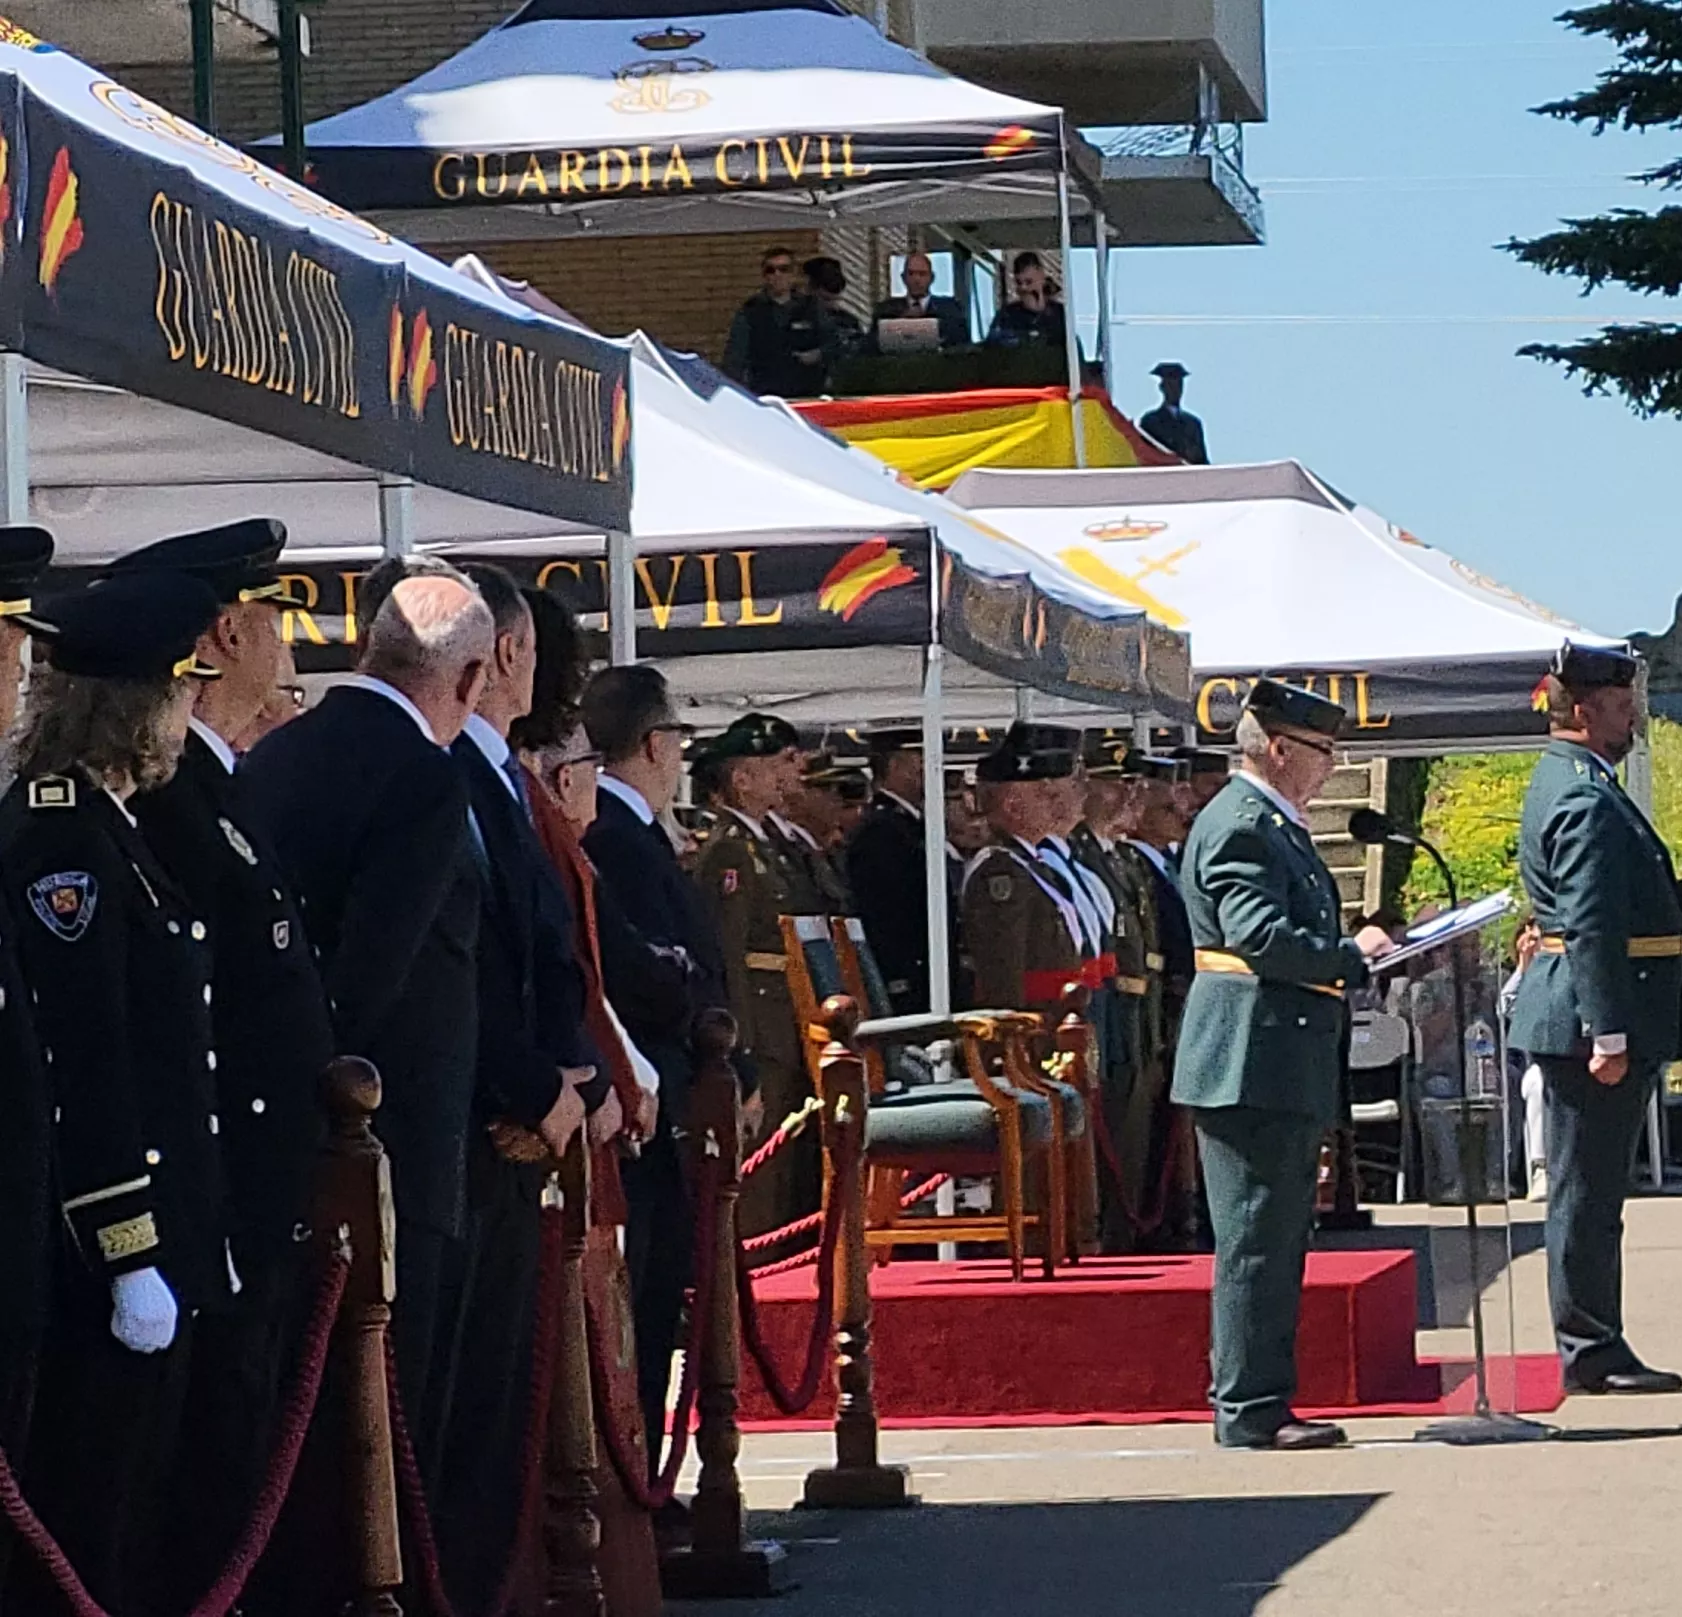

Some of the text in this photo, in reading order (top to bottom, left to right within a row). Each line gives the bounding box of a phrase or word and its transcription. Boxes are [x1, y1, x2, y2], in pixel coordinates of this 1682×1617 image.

[433, 134, 872, 200] GUARDIA CIVIL
[151, 191, 360, 418] GUARDIA CIVIL
[445, 323, 610, 482] GUARDIA CIVIL
